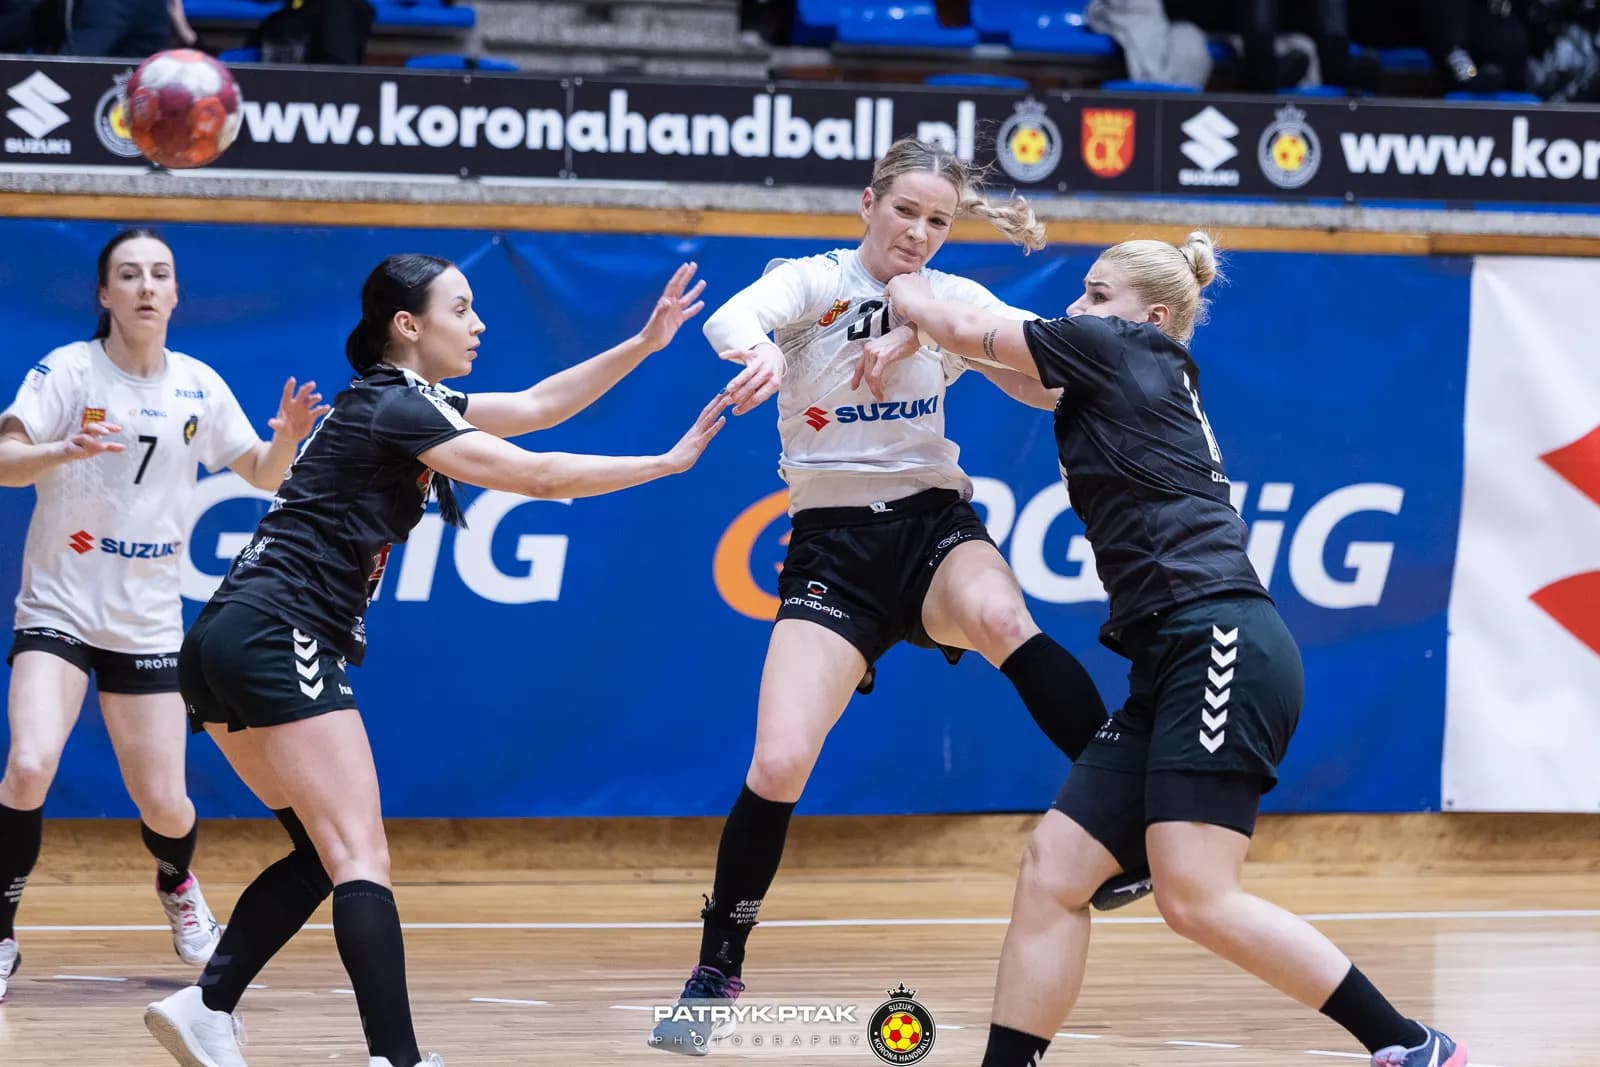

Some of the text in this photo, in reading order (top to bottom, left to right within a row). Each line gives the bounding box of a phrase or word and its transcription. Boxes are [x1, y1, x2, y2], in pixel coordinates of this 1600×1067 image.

[240, 82, 976, 161] ww.koronahandballpl
[4, 138, 71, 154] SUZUKI
[1178, 168, 1240, 186] SUZUKI
[834, 394, 939, 424] SUZUKI
[133, 434, 159, 485] 7
[100, 537, 182, 559] SUZUK
